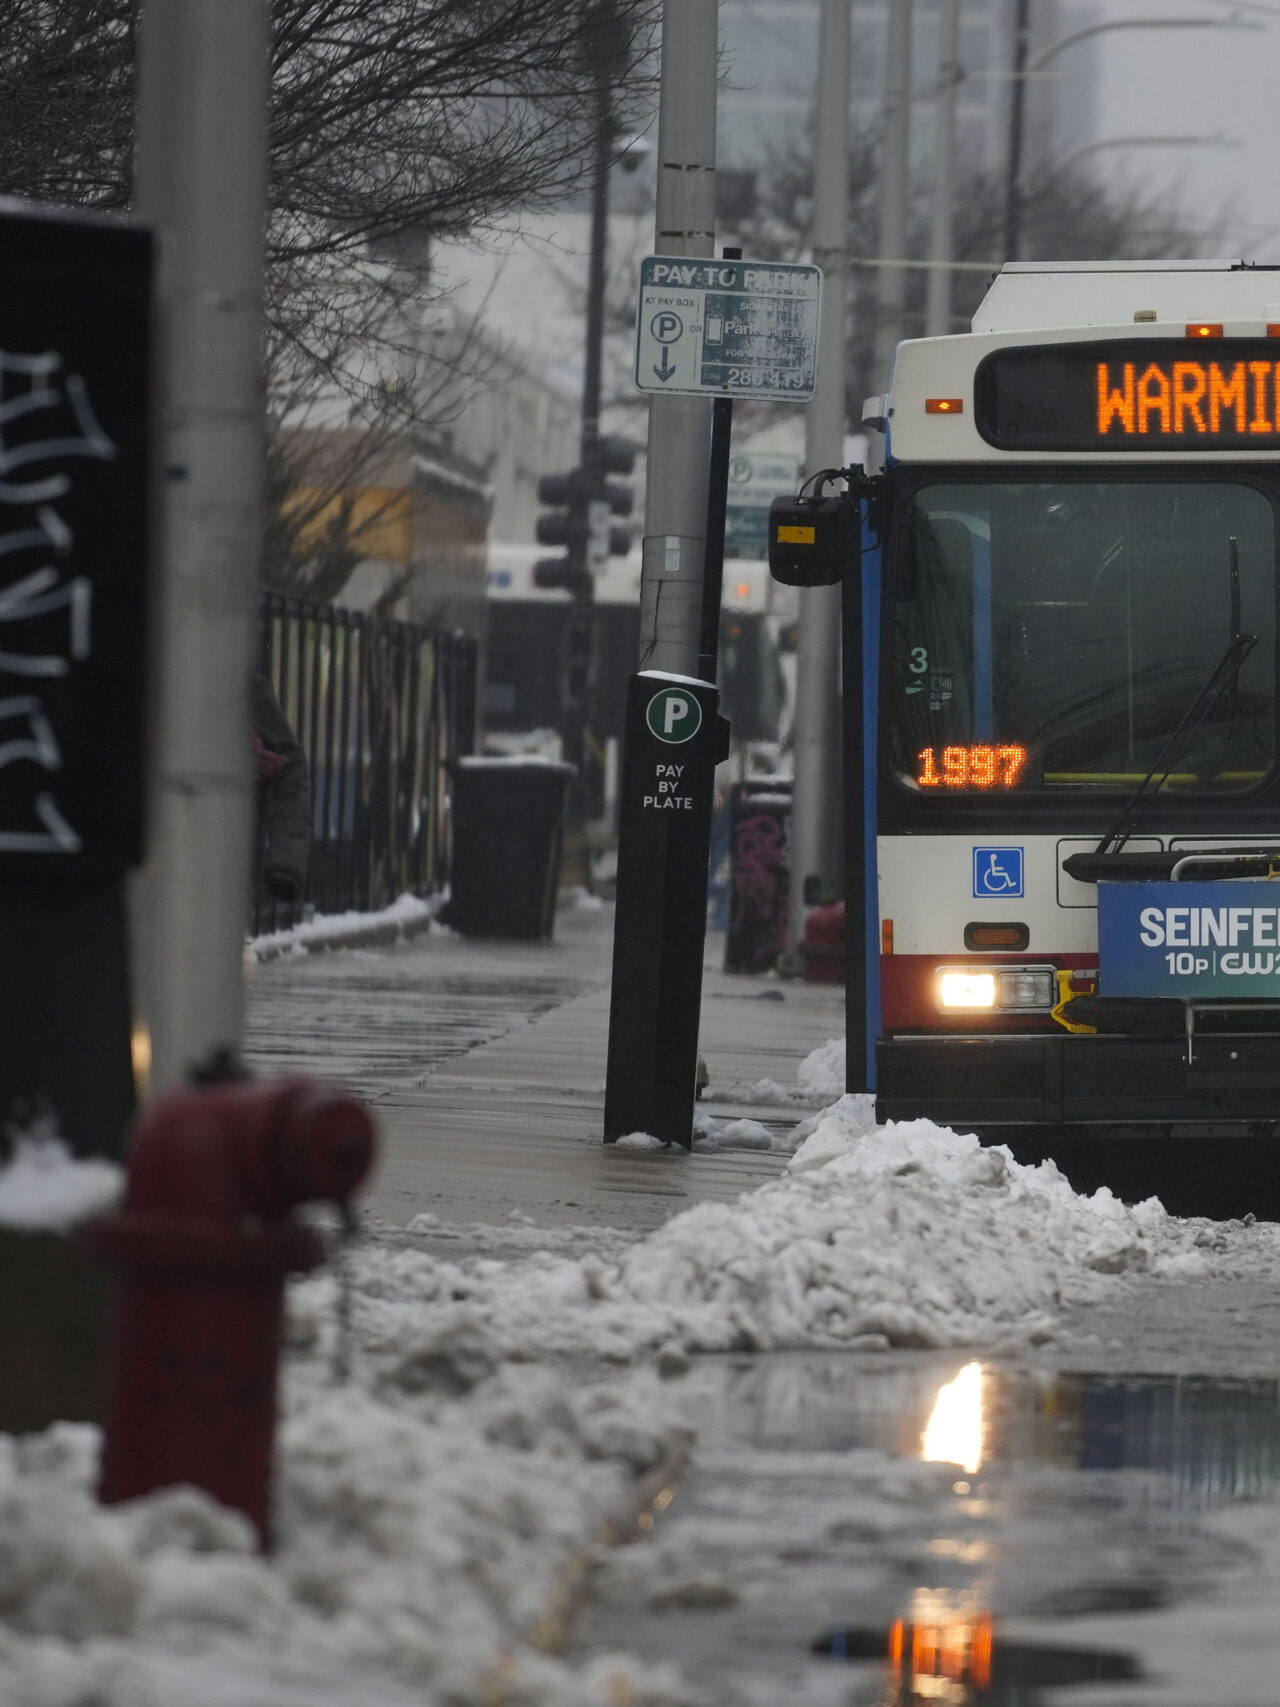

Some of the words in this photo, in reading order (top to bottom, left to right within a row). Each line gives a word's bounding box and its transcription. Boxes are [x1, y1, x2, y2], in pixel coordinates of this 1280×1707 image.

[652, 265, 697, 286] PAY
[703, 267, 737, 287] TO
[645, 297, 656, 305] AT
[658, 298, 673, 306] PAY
[677, 299, 696, 308] BOX
[658, 316, 677, 338] P
[689, 325, 702, 333] OR
[909, 647, 928, 673] 3
[664, 697, 689, 734] P
[656, 764, 685, 777] PAY
[918, 745, 1025, 785] 1997
[658, 781, 679, 793] BY
[643, 796, 693, 809] PLATE
